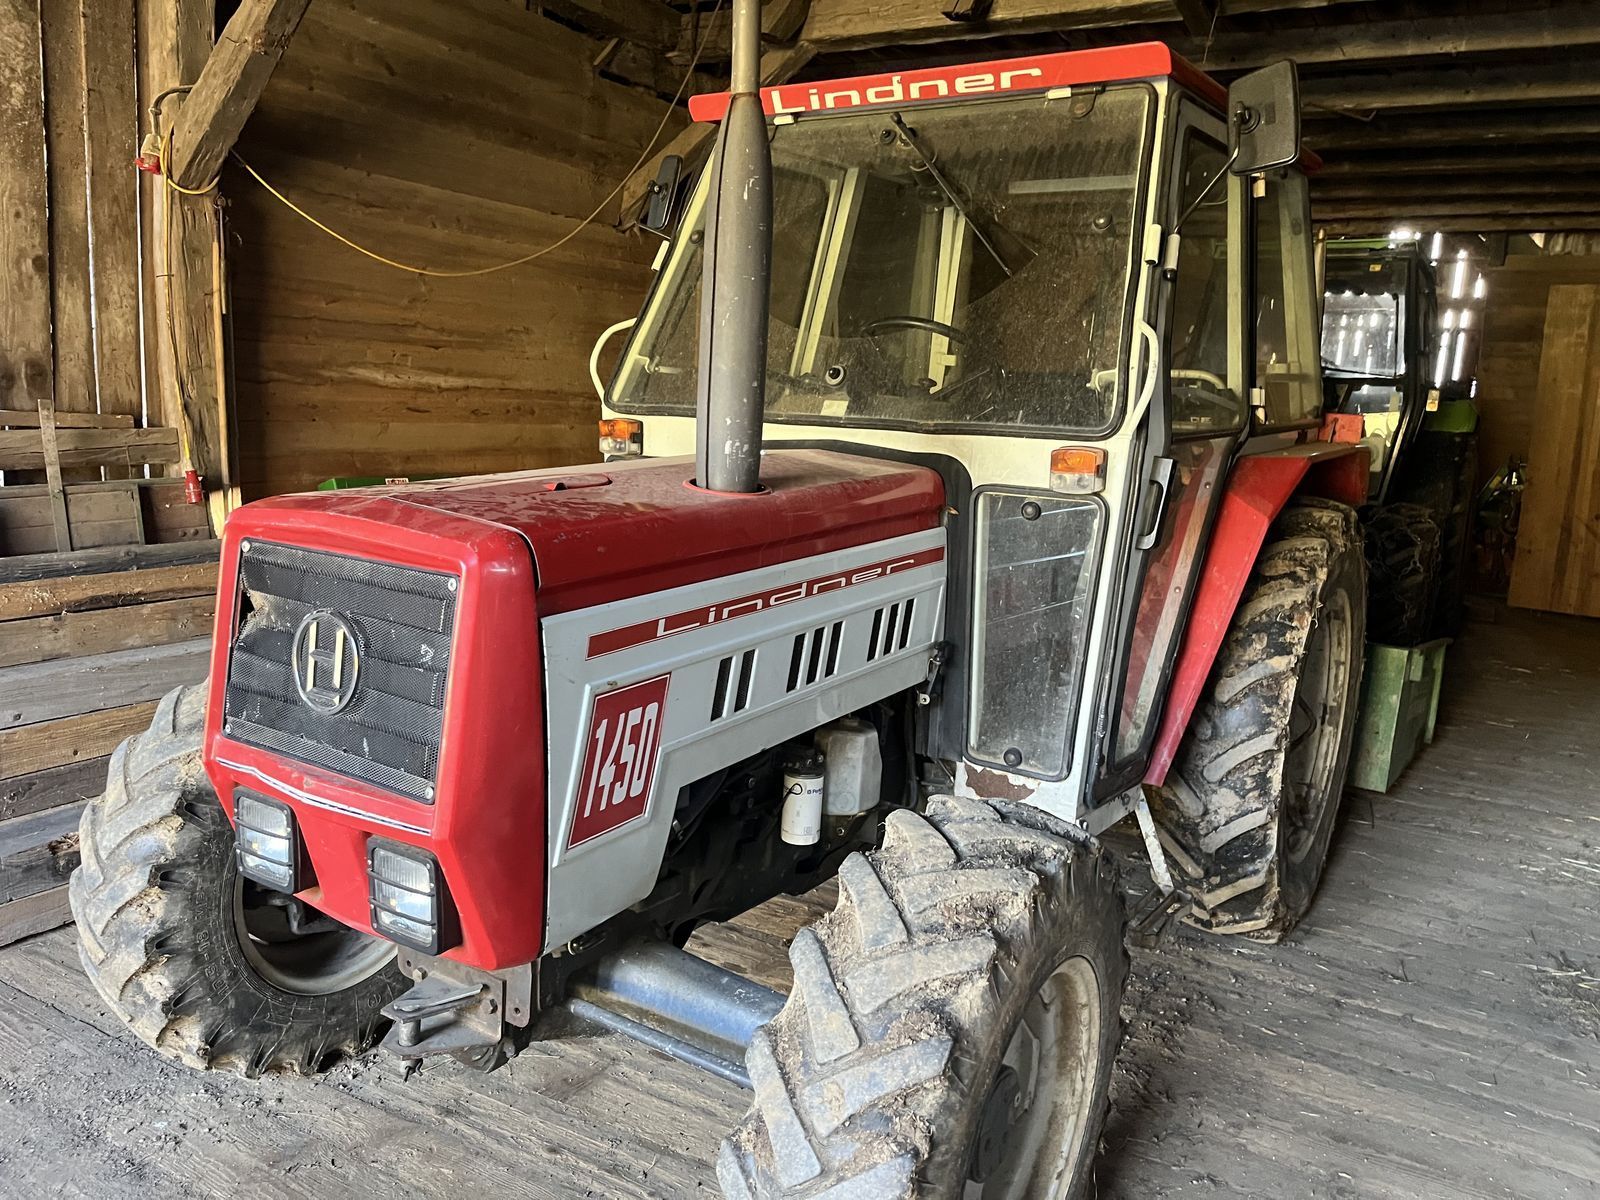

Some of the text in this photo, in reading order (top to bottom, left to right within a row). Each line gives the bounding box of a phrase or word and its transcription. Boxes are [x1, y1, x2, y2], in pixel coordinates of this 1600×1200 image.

[771, 68, 1042, 114] Lindner
[656, 559, 914, 637] Lindner
[584, 702, 658, 818] 1450
